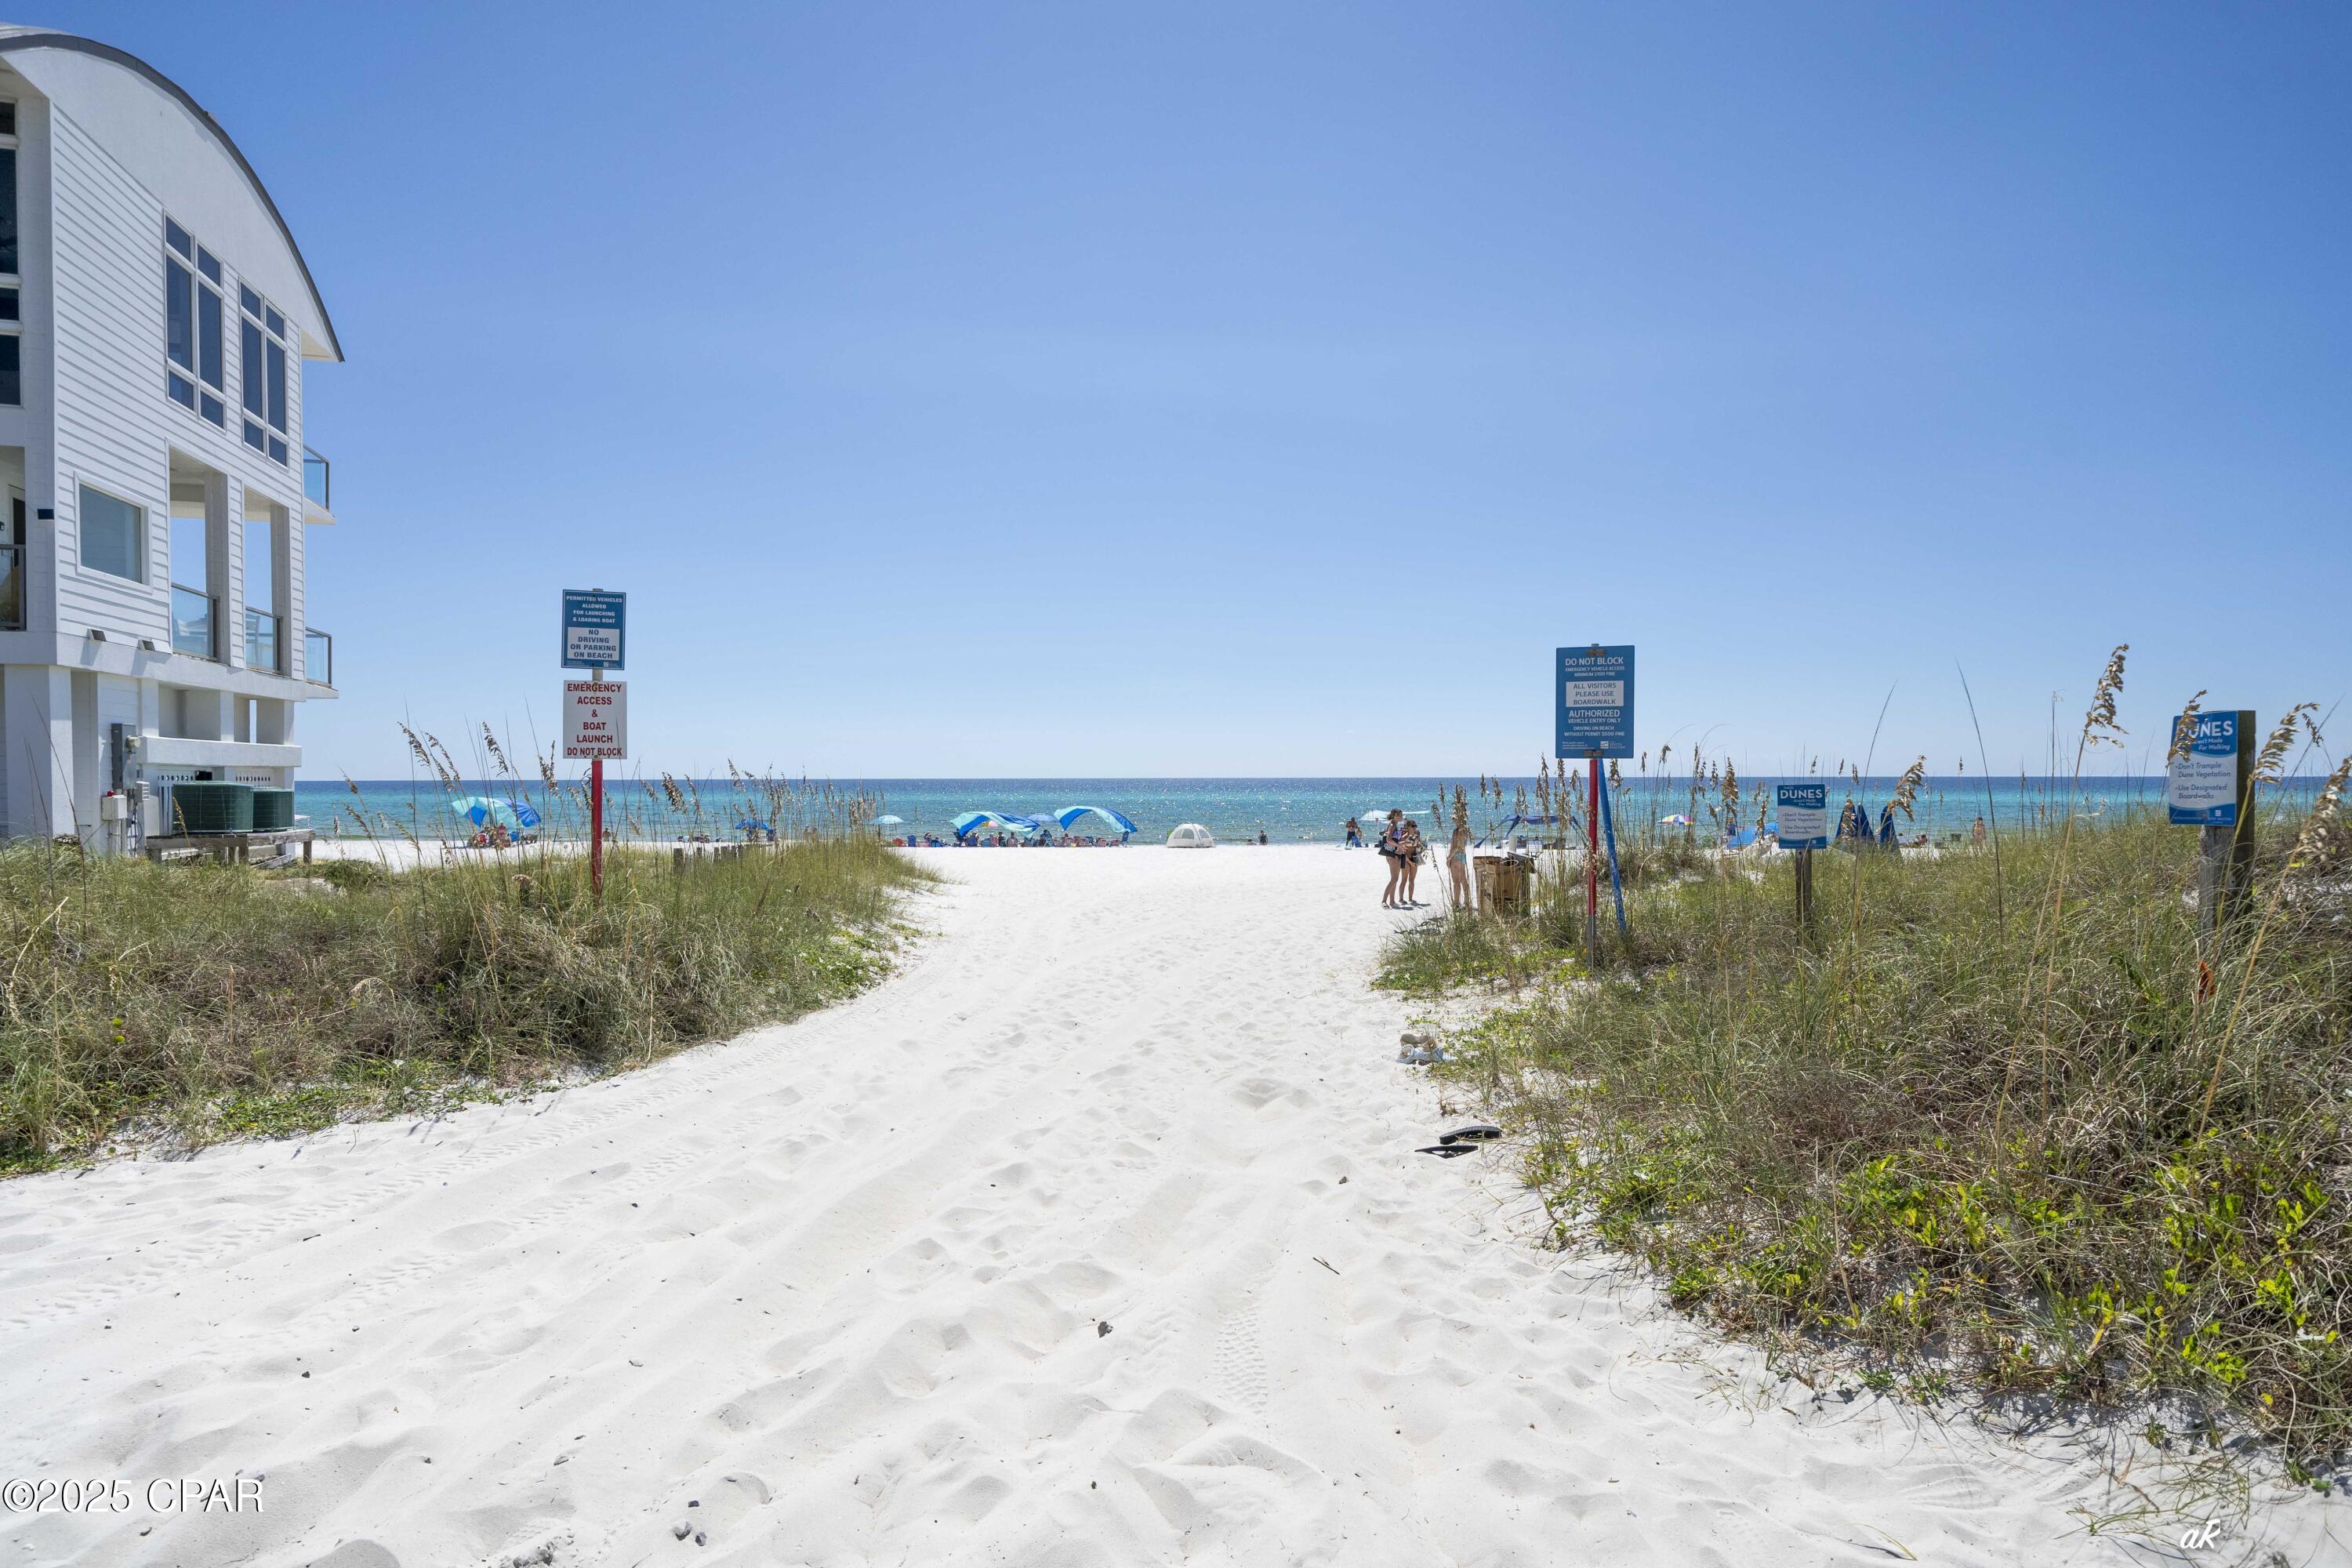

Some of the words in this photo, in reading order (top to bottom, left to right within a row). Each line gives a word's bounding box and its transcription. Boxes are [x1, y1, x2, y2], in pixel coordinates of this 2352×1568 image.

[1597, 656, 1624, 665] BLOCK
[567, 683, 622, 692] EMERGENCY
[577, 696, 612, 705] ACCESS
[591, 709, 598, 717] &
[1569, 709, 1621, 717] AUTHORIZED
[583, 721, 607, 731] BOAT
[2181, 720, 2234, 739] UNES
[577, 735, 613, 743] LAUNCH
[567, 747, 578, 756] DO
[579, 747, 595, 756] NOT
[597, 747, 622, 756] BLOCK
[2196, 761, 2222, 770] Trample
[2190, 783, 2227, 792] Designated
[1780, 789, 1823, 799] DUNES
[2178, 791, 2214, 800] Boardwalks
